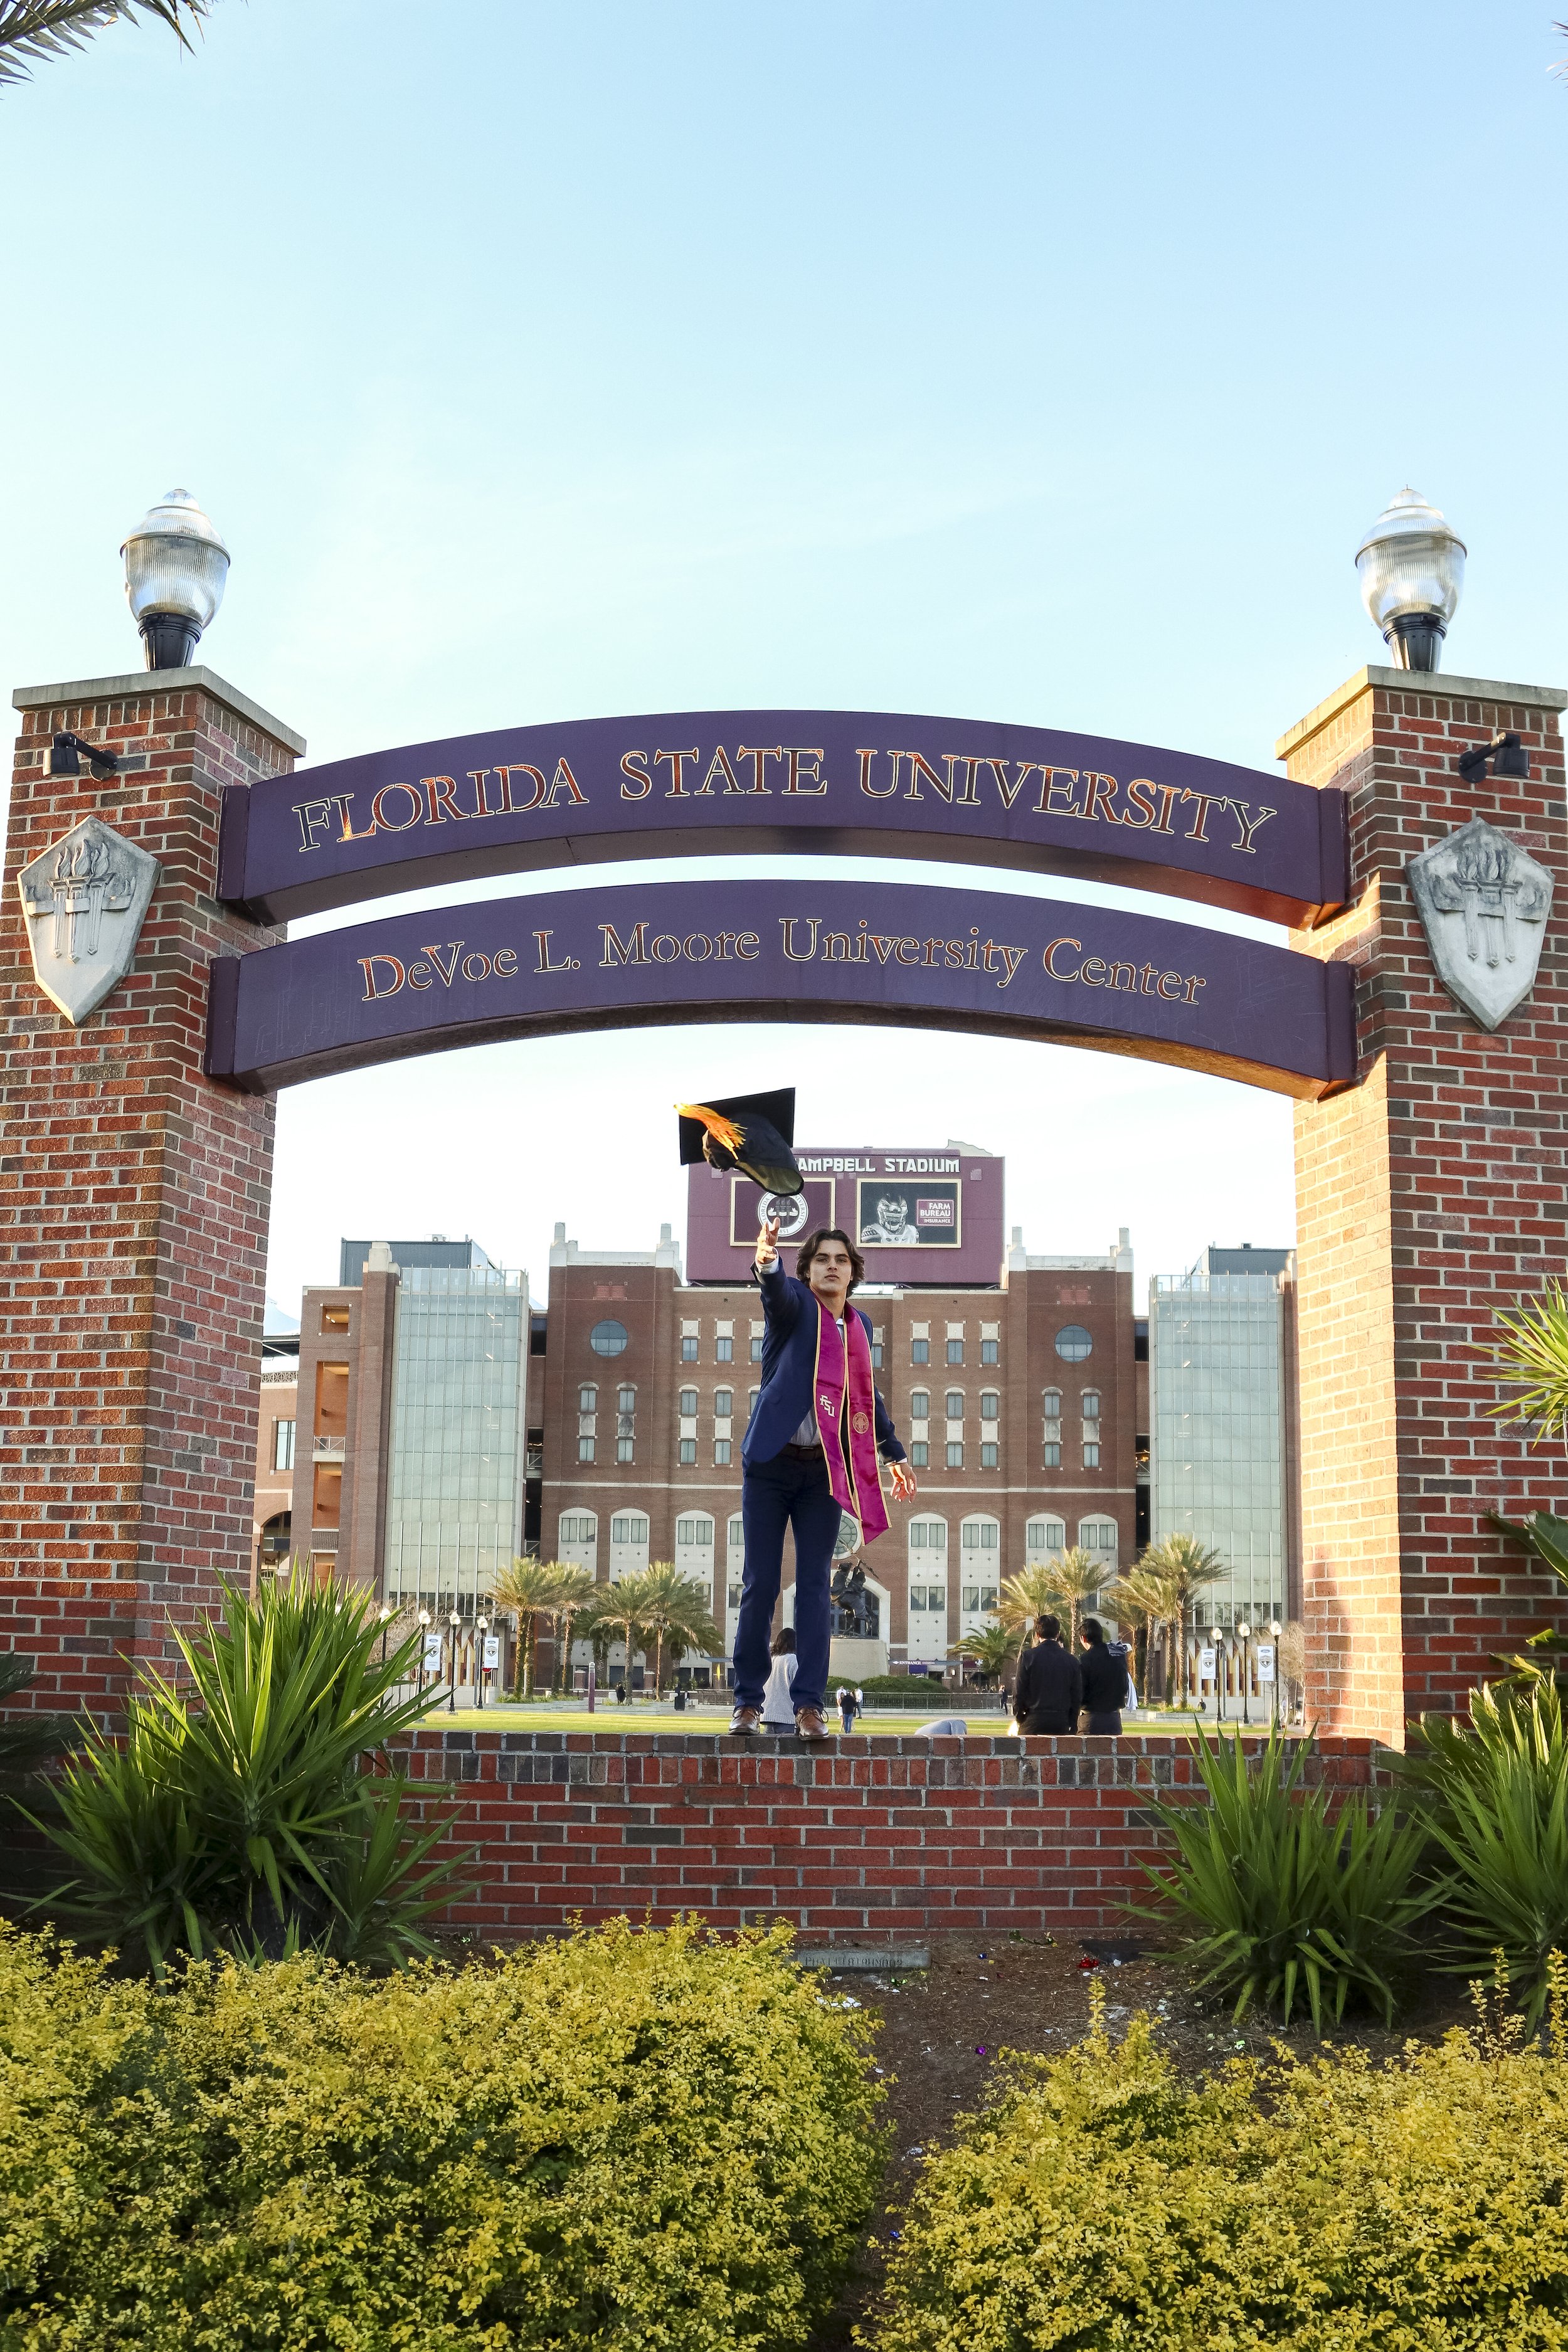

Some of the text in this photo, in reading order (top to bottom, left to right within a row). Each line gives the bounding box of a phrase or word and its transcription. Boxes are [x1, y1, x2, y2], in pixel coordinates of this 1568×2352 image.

[292, 744, 1278, 854] FLORIDA STATE UNIVERSITY
[357, 918, 1207, 1005] DeVoe L. Moore University Center
[795, 1158, 960, 1173] AMPBELL STADIUM
[761, 1197, 770, 1221] LORIDA
[793, 1195, 805, 1224] NIVERSITY
[820, 1394, 835, 1417] FSU
